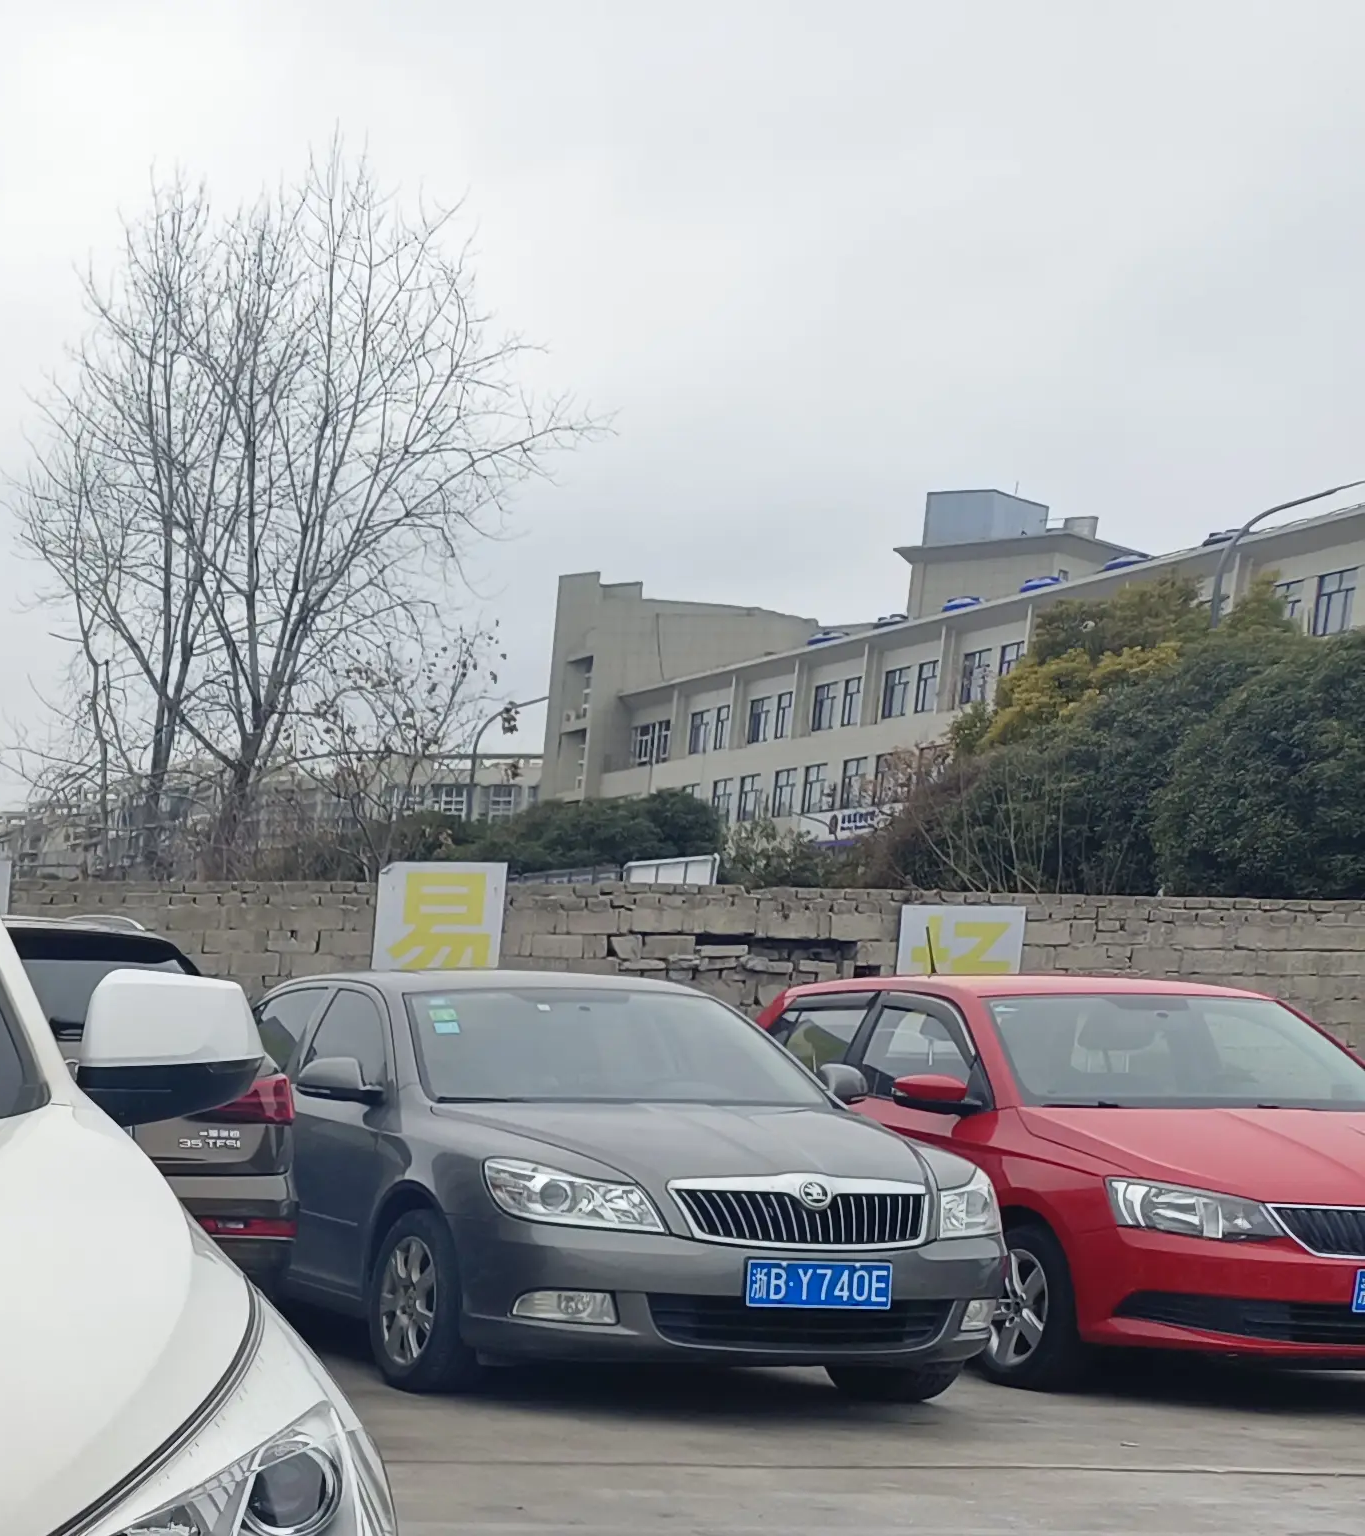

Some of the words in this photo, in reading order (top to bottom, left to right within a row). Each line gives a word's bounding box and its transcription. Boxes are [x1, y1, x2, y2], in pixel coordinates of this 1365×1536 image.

[385, 872, 492, 969] 易
[179, 1138, 203, 1148] 35
[205, 1138, 241, 1149] TFSI
